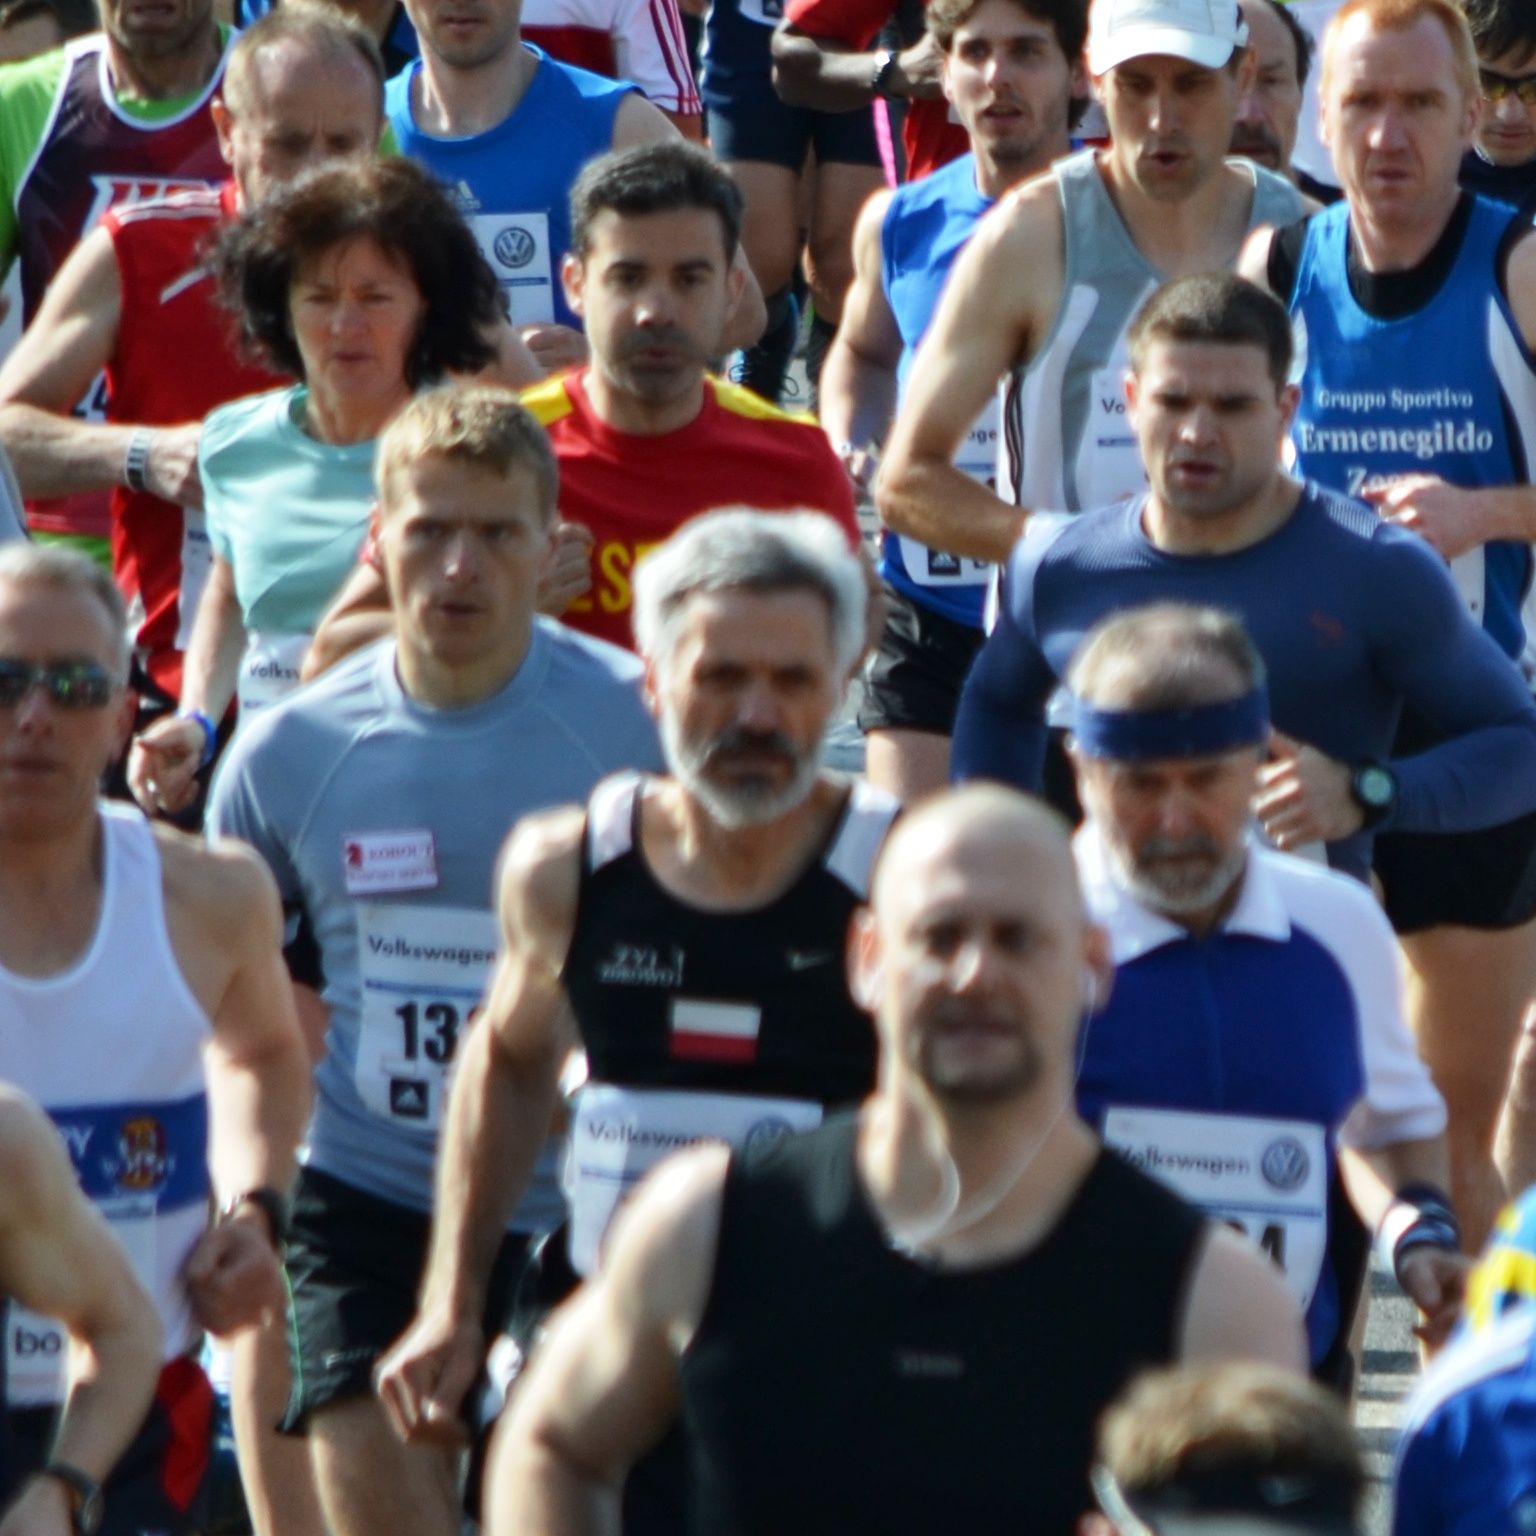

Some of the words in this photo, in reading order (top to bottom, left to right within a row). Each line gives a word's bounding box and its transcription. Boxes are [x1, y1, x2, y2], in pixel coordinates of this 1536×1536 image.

[1318, 389, 1384, 413] Gruppo
[1390, 389, 1474, 413] Sportivo
[1301, 416, 1494, 460] Ermenegildo
